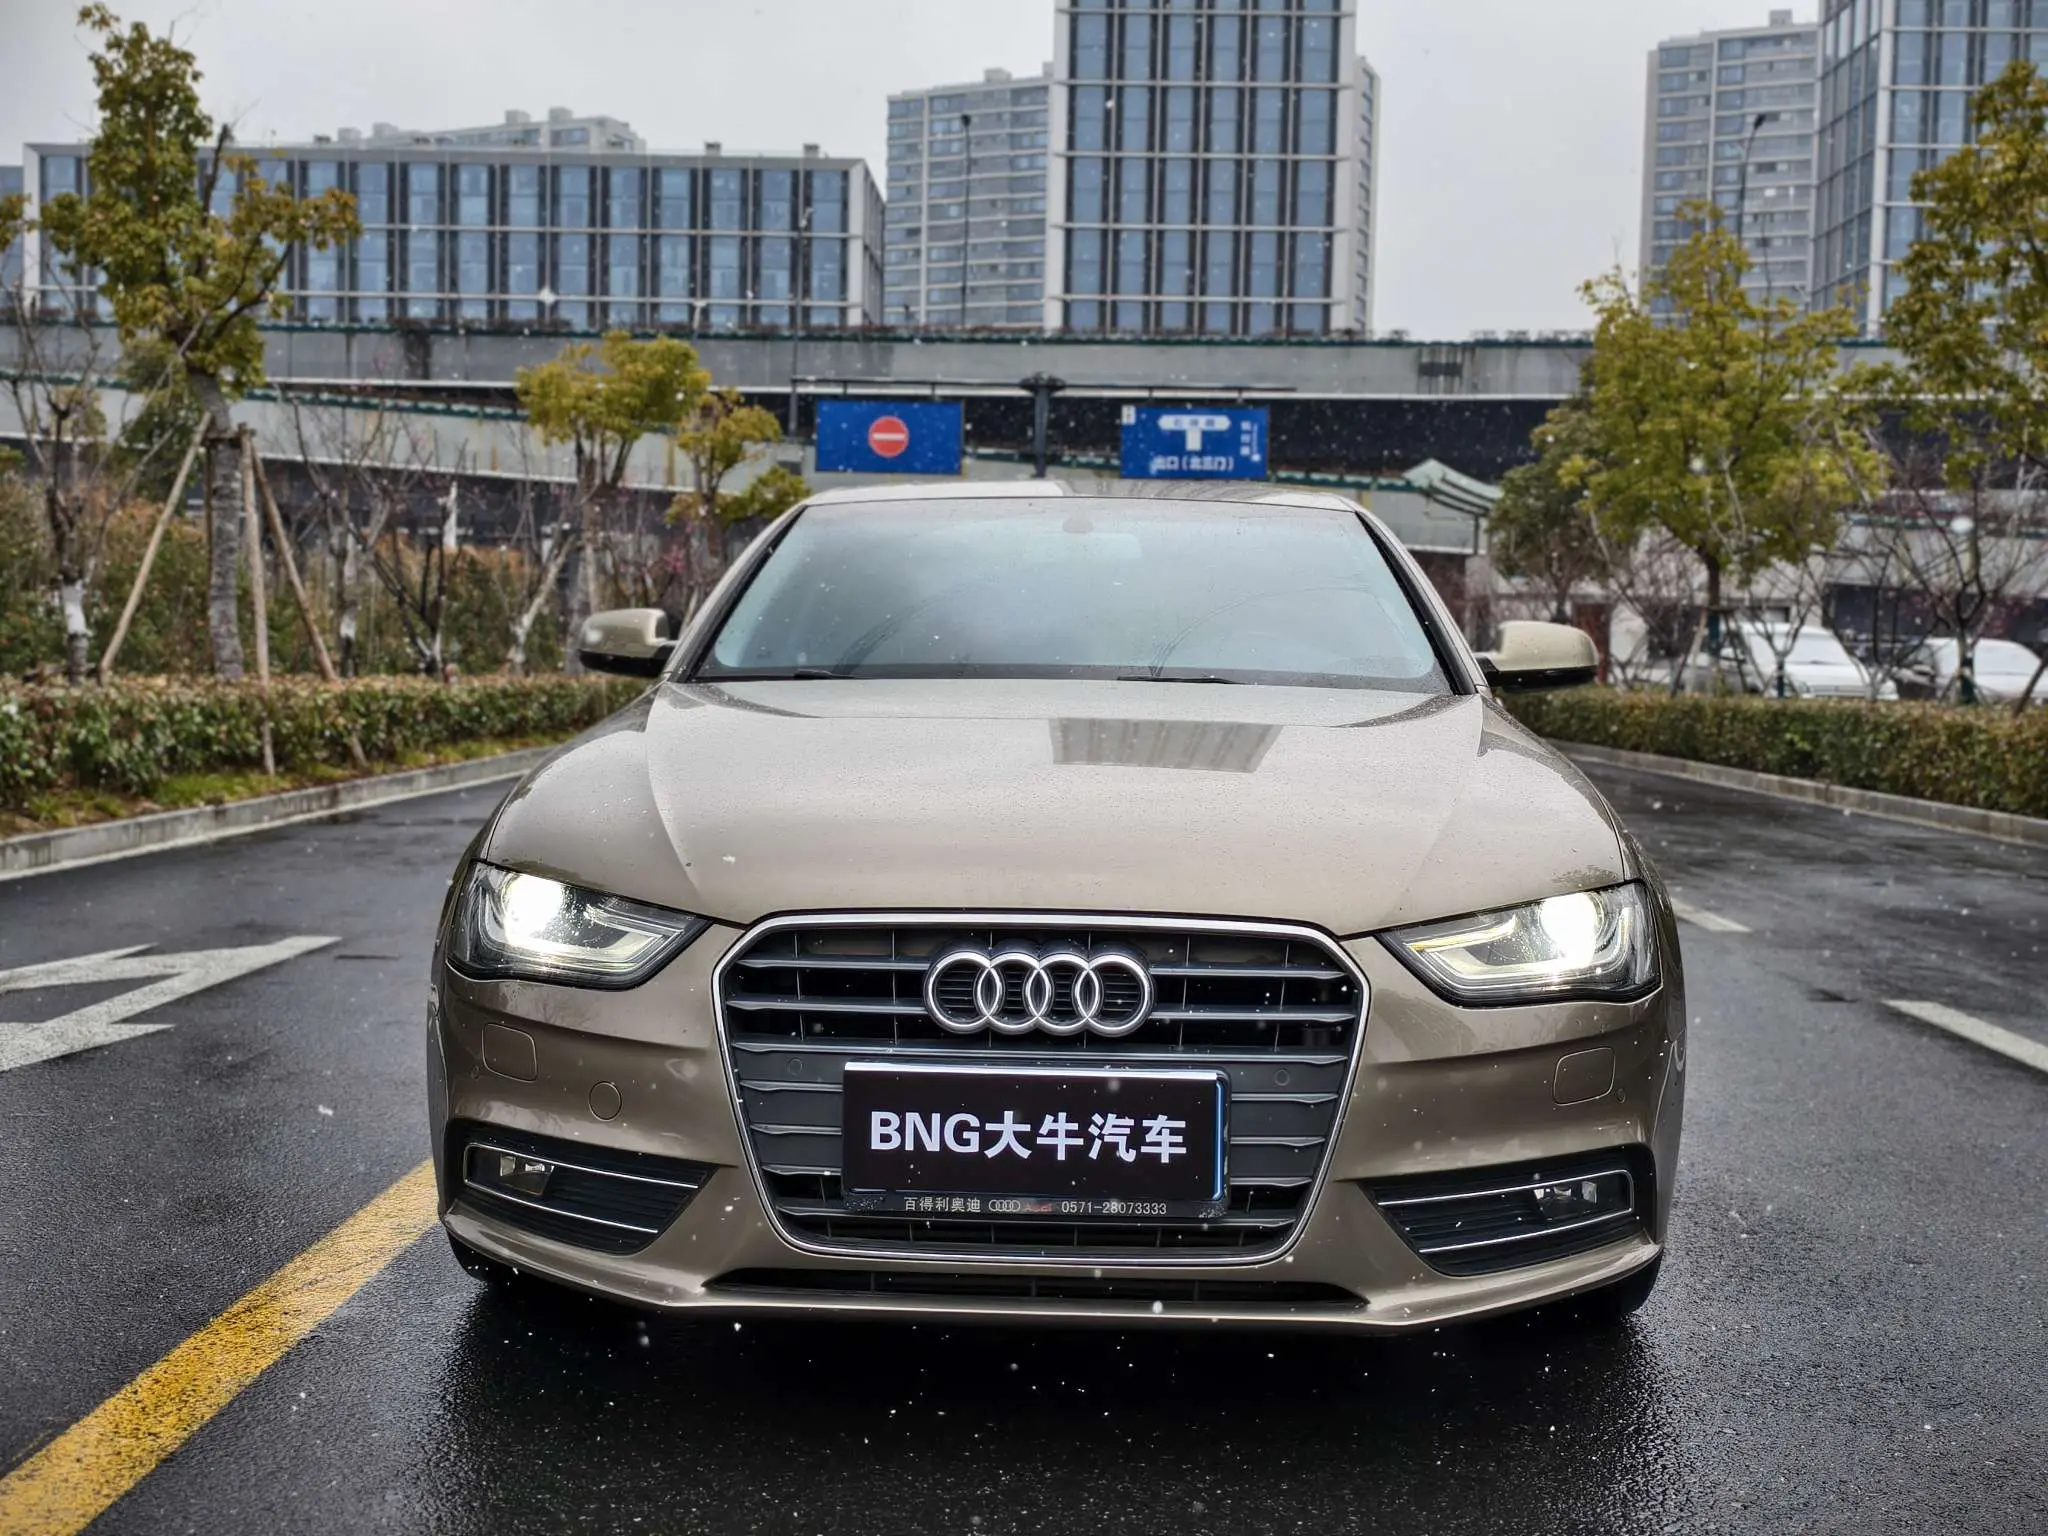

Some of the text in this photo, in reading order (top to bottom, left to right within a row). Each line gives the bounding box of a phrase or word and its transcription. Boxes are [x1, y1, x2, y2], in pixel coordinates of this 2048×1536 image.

[870, 1110, 1187, 1164] BNG大牛汽车
[903, 1196, 981, 1213] 百得利奥迪
[1061, 1200, 1168, 1215] 0571-28073333
